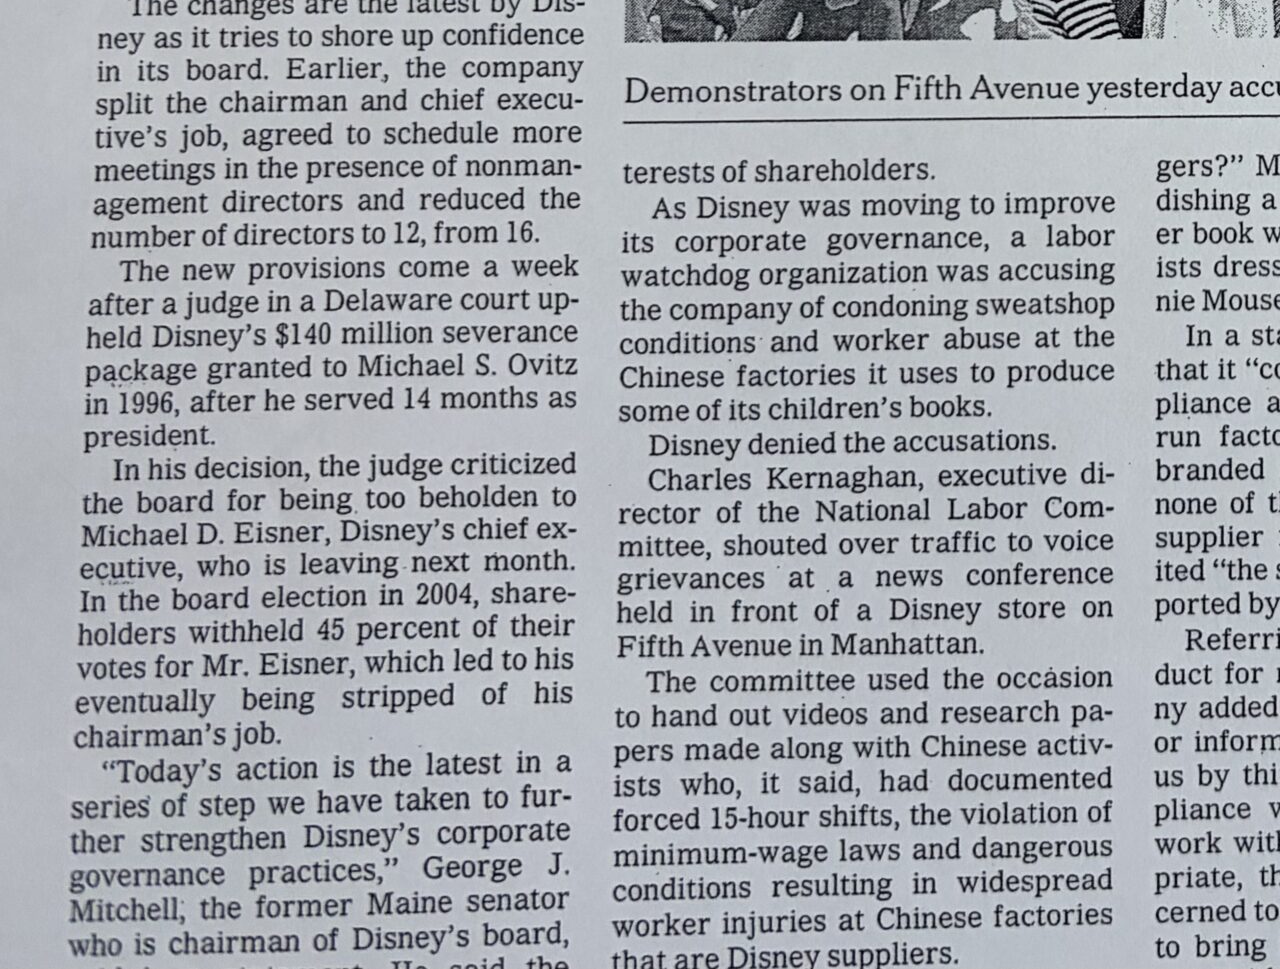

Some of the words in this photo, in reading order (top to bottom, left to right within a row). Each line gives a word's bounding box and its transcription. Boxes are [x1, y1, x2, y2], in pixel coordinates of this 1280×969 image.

[624, 76, 843, 104] Demonstrators
[849, 83, 886, 102] on
[894, 73, 963, 101] Fifth
[969, 73, 1080, 101] Avenue
[1086, 71, 1224, 106] yesterday
[651, 196, 687, 220] As
[695, 195, 791, 225] Disney
[798, 199, 851, 218] was
[861, 192, 961, 222] moving
[969, 194, 996, 216] to
[1004, 191, 1116, 220] improve
[90, 224, 197, 250] number
[201, 222, 229, 247] of
[233, 222, 355, 247] directors
[361, 223, 387, 245] to
[393, 220, 427, 249] 12,
[433, 220, 499, 244] from
[506, 219, 540, 244] 16.
[1155, 288, 1196, 313] nie
[648, 434, 742, 462] Disney
[747, 430, 837, 456] denied
[842, 430, 886, 455] the
[892, 428, 1057, 454] accusations.
[1154, 496, 1218, 516] none
[1229, 490, 1256, 515] of
[79, 590, 107, 613] In
[117, 588, 161, 612] the
[171, 585, 250, 611] board
[261, 584, 368, 609] election
[378, 583, 404, 607] in
[415, 582, 480, 610] 2004,
[490, 580, 577, 605] share-
[616, 633, 685, 659] Fifth
[690, 634, 792, 658] Avenue
[799, 633, 824, 657] in
[830, 631, 985, 657] Manhattan.
[1154, 897, 1247, 924] cerned
[1253, 900, 1280, 922] to
